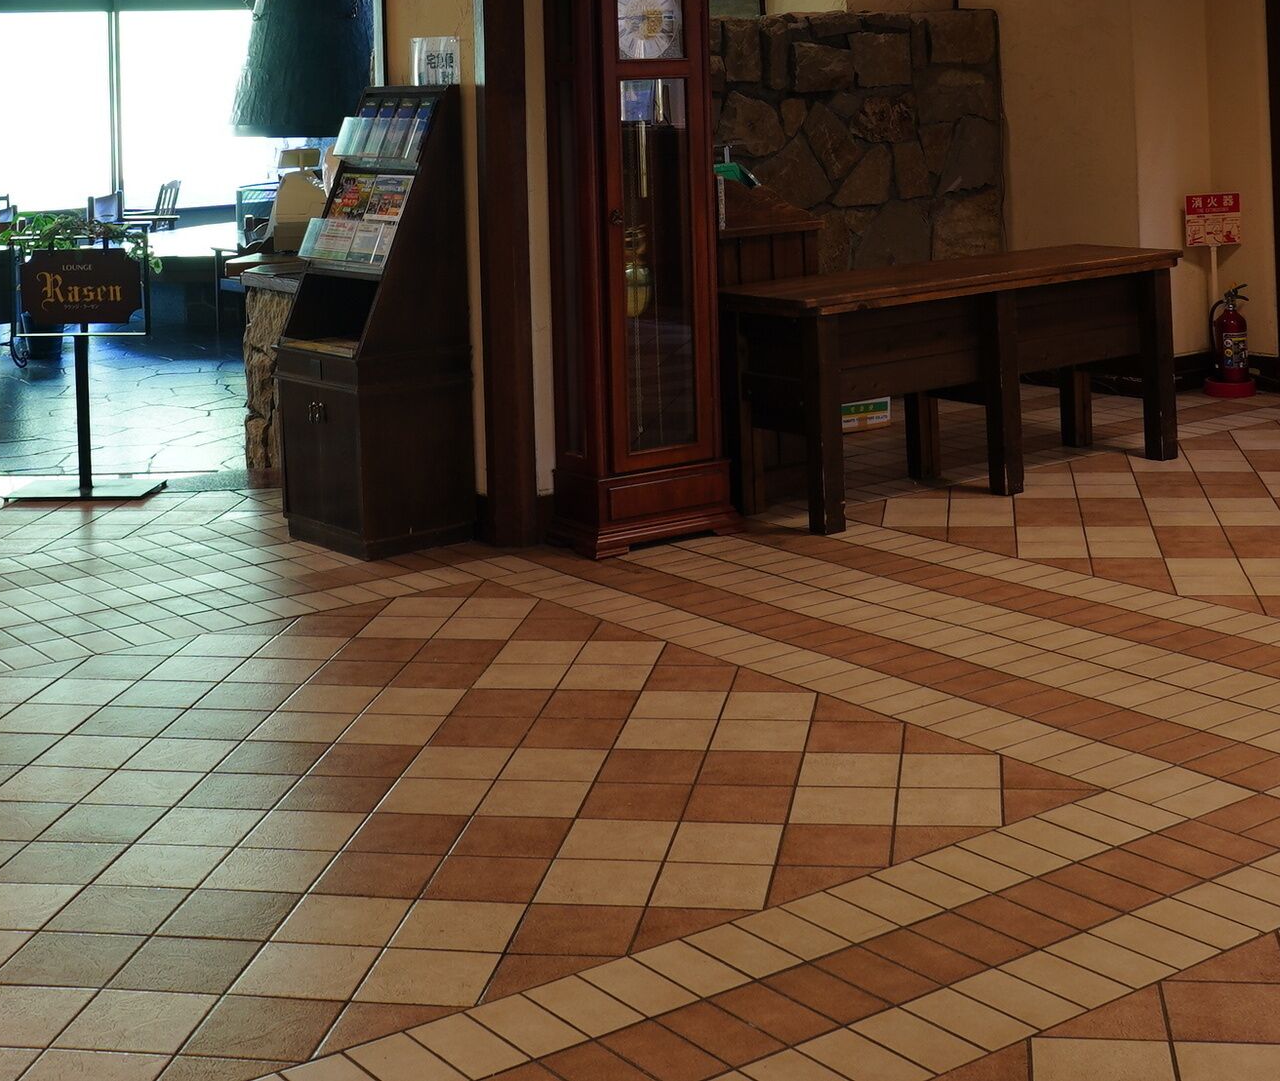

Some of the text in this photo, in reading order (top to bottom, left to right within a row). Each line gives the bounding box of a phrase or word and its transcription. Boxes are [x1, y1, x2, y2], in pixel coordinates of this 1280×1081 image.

[1191, 196, 1234, 208] 消火器
[36, 272, 122, 312] Rasen
